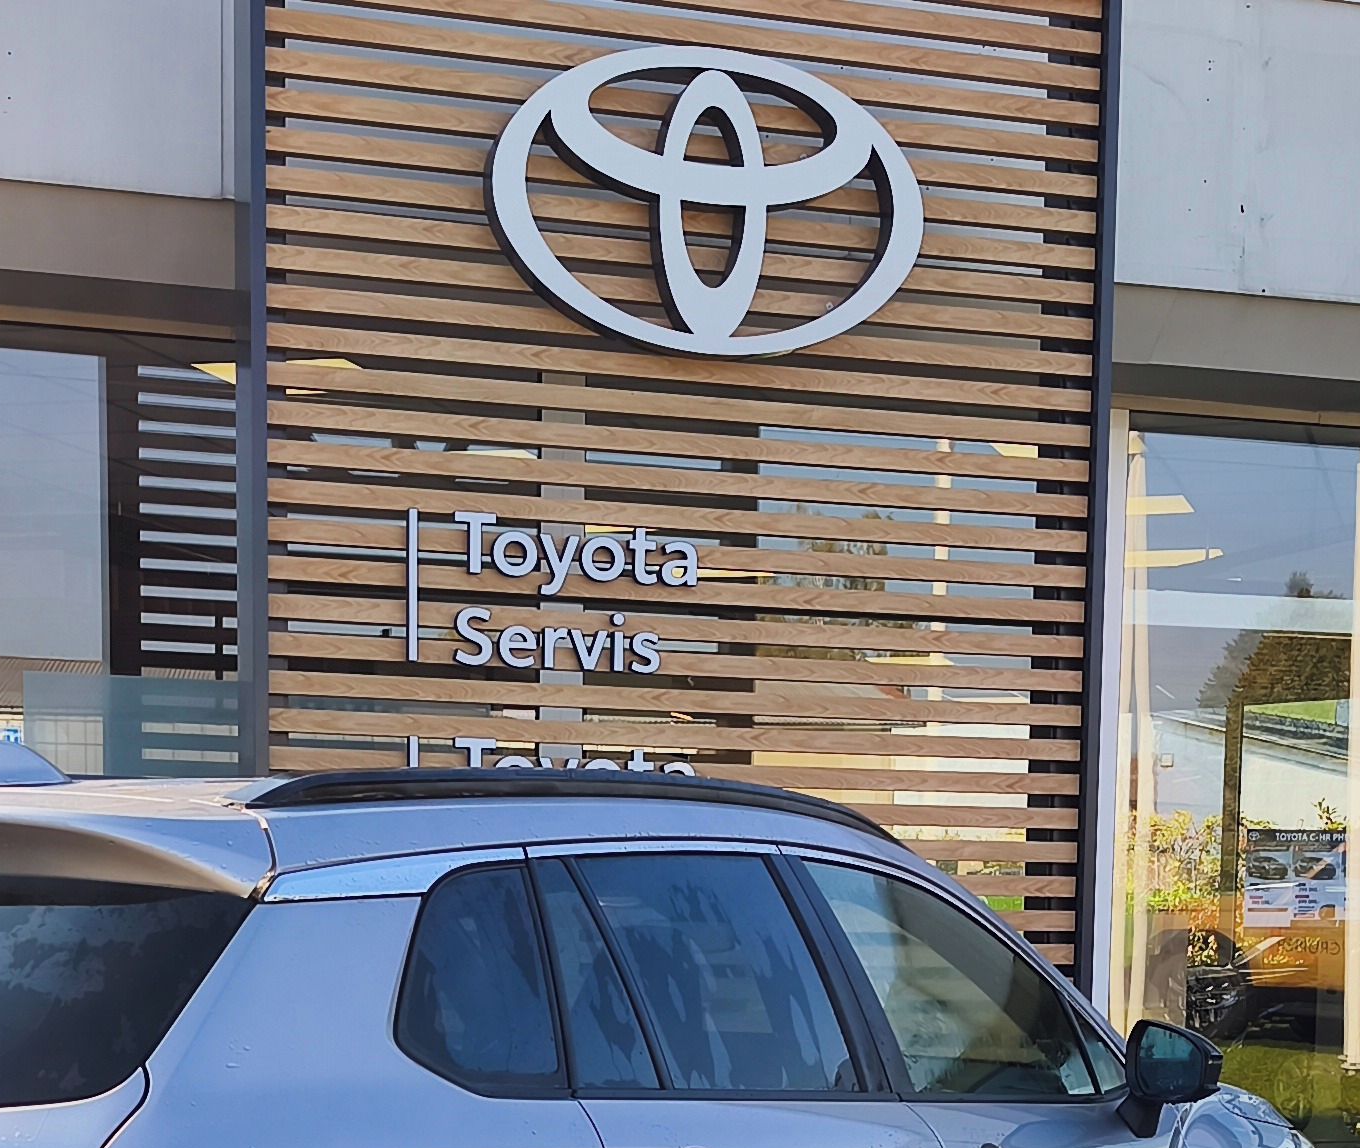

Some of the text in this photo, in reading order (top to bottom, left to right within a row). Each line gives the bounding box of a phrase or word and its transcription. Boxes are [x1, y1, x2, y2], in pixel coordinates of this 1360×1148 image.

[454, 510, 699, 596] Toyota
[454, 606, 662, 675] Servis
[1275, 832, 1308, 842] TOYOTA
[1309, 833, 1331, 842] C-HR
